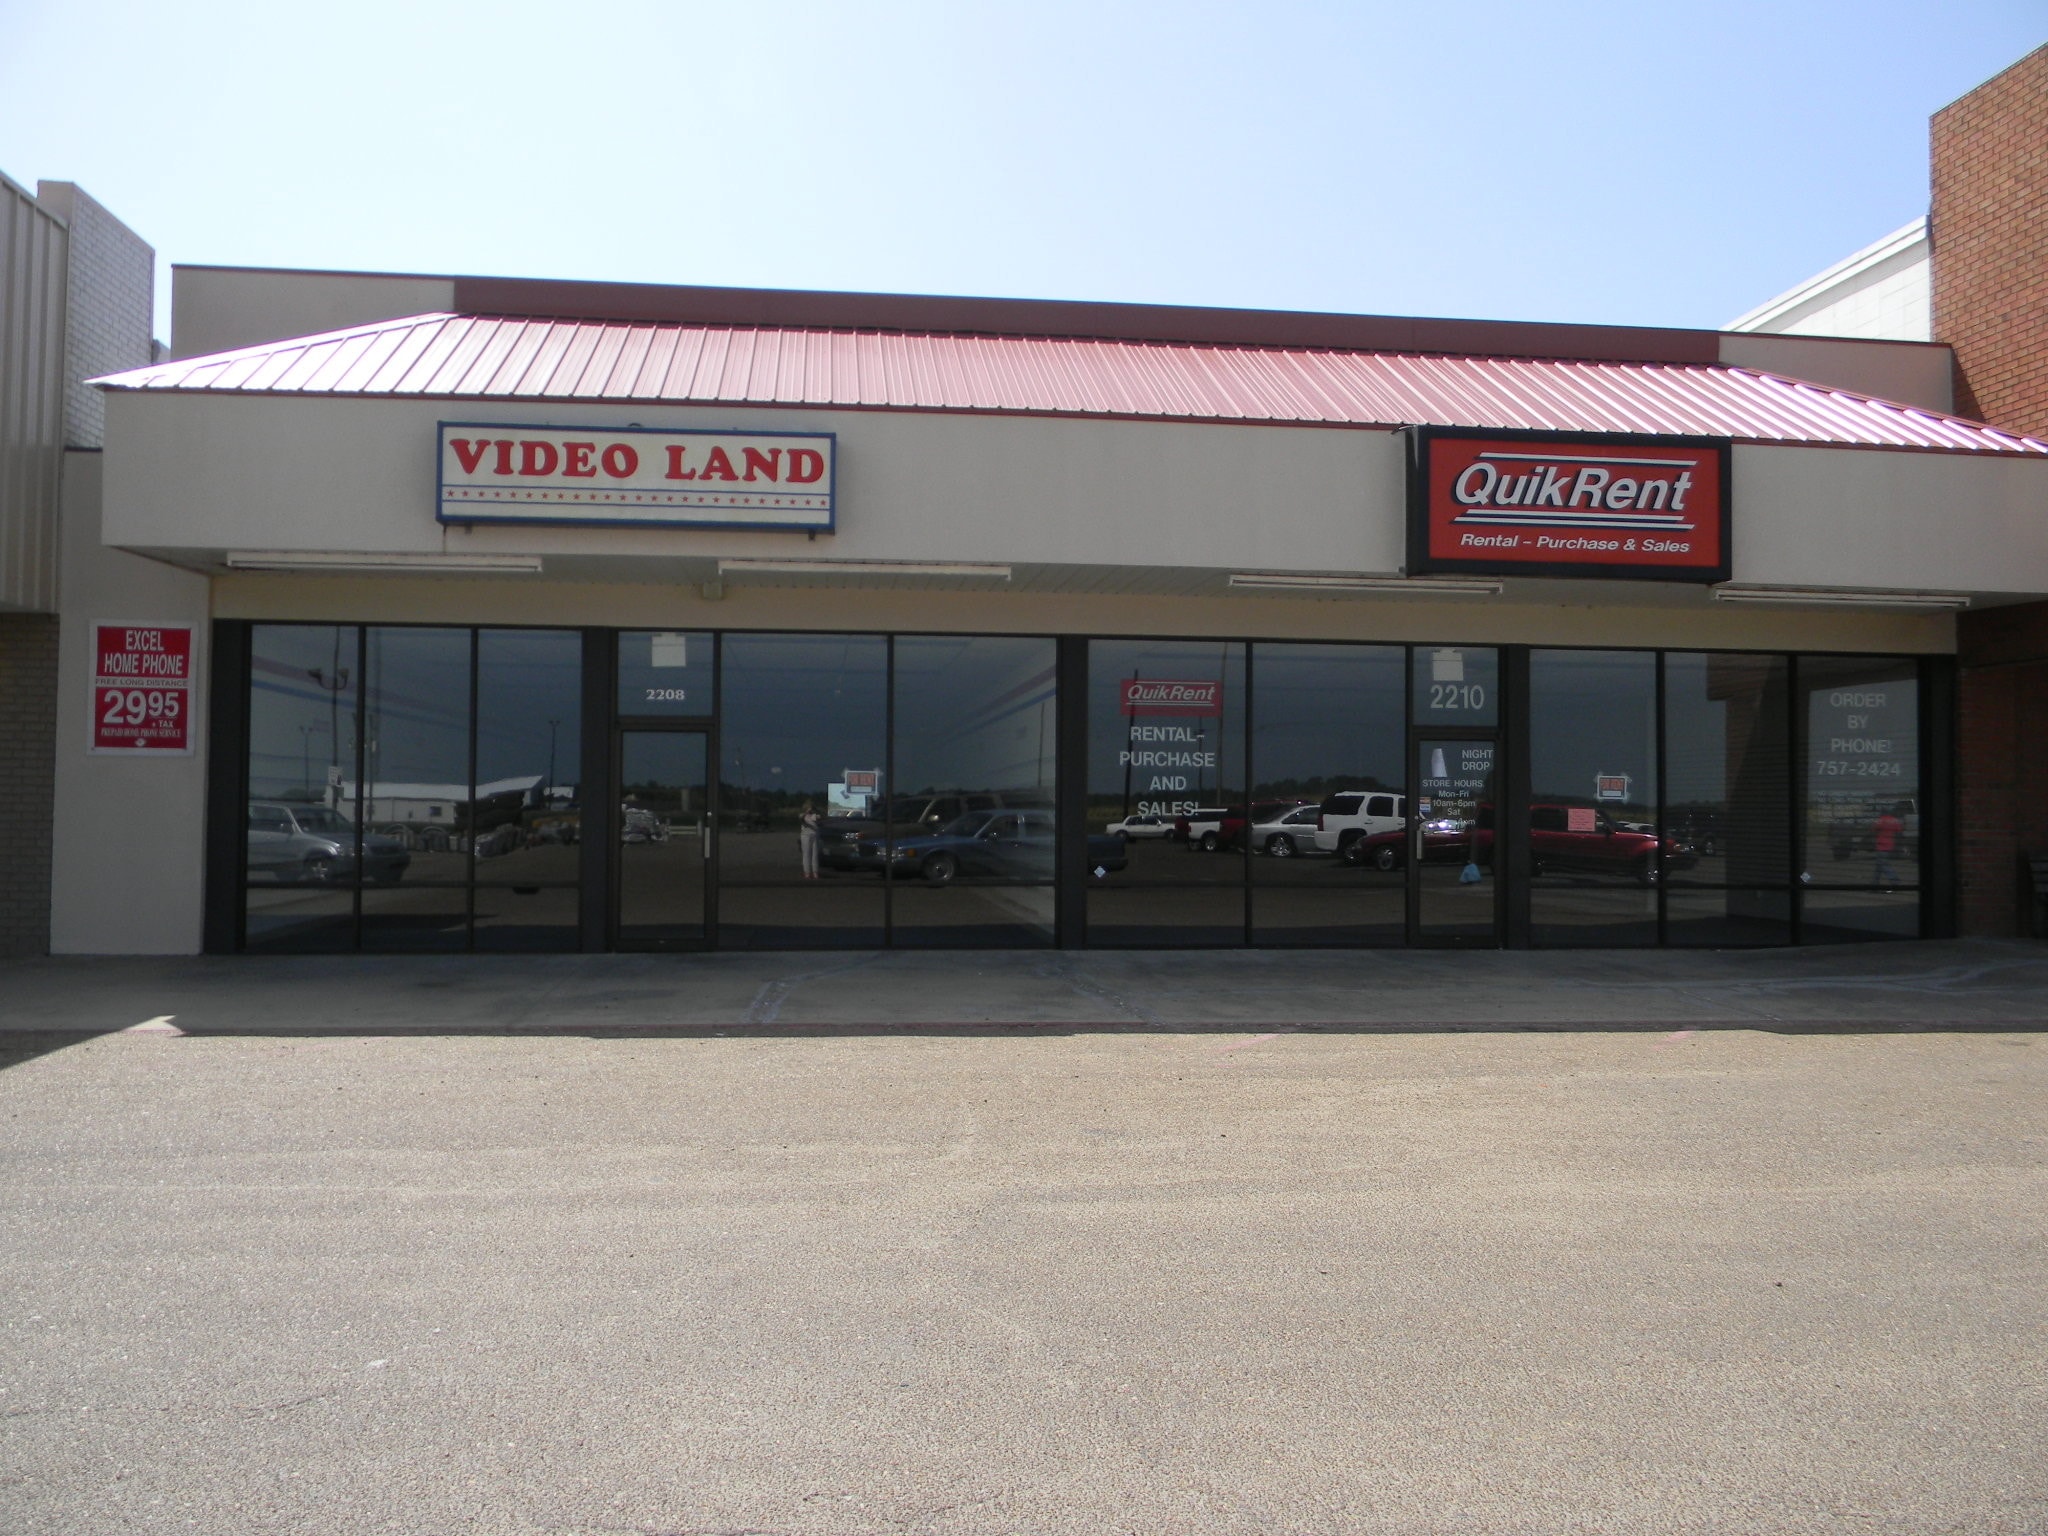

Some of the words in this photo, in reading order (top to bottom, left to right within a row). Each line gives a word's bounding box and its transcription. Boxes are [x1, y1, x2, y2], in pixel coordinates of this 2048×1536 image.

[449, 438, 638, 478] VIDEO
[664, 444, 824, 483] LAND
[1454, 462, 1692, 511] QuikRent
[1460, 533, 1519, 547] Rental
[1536, 536, 1619, 551] Purchase
[1623, 538, 1636, 551] &
[1641, 539, 1690, 553] Sales
[126, 629, 164, 651] EXCEL
[104, 653, 139, 673] HOME
[142, 654, 184, 675] PHONE
[146, 679, 188, 687] DISTANCE
[646, 689, 685, 700] 2208
[1127, 684, 1215, 700] QuikRent
[1430, 685, 1484, 710] 2210
[1830, 692, 1886, 707] ORDER
[159, 720, 173, 728] TAX
[1847, 715, 1869, 729] BY
[1120, 751, 1215, 767] PURCHASE
[1462, 749, 1493, 759] NIGHT
[1462, 761, 1490, 771] DROP
[1816, 760, 1900, 776] 757-2424
[1149, 776, 1187, 791] AND
[1422, 779, 1450, 787] STORE
[1438, 790, 1469, 798] Mon-Fri
[1137, 801, 1200, 816] SALES!
[1433, 799, 1476, 807] 10am-6pm
[1447, 808, 1460, 816] Sat
